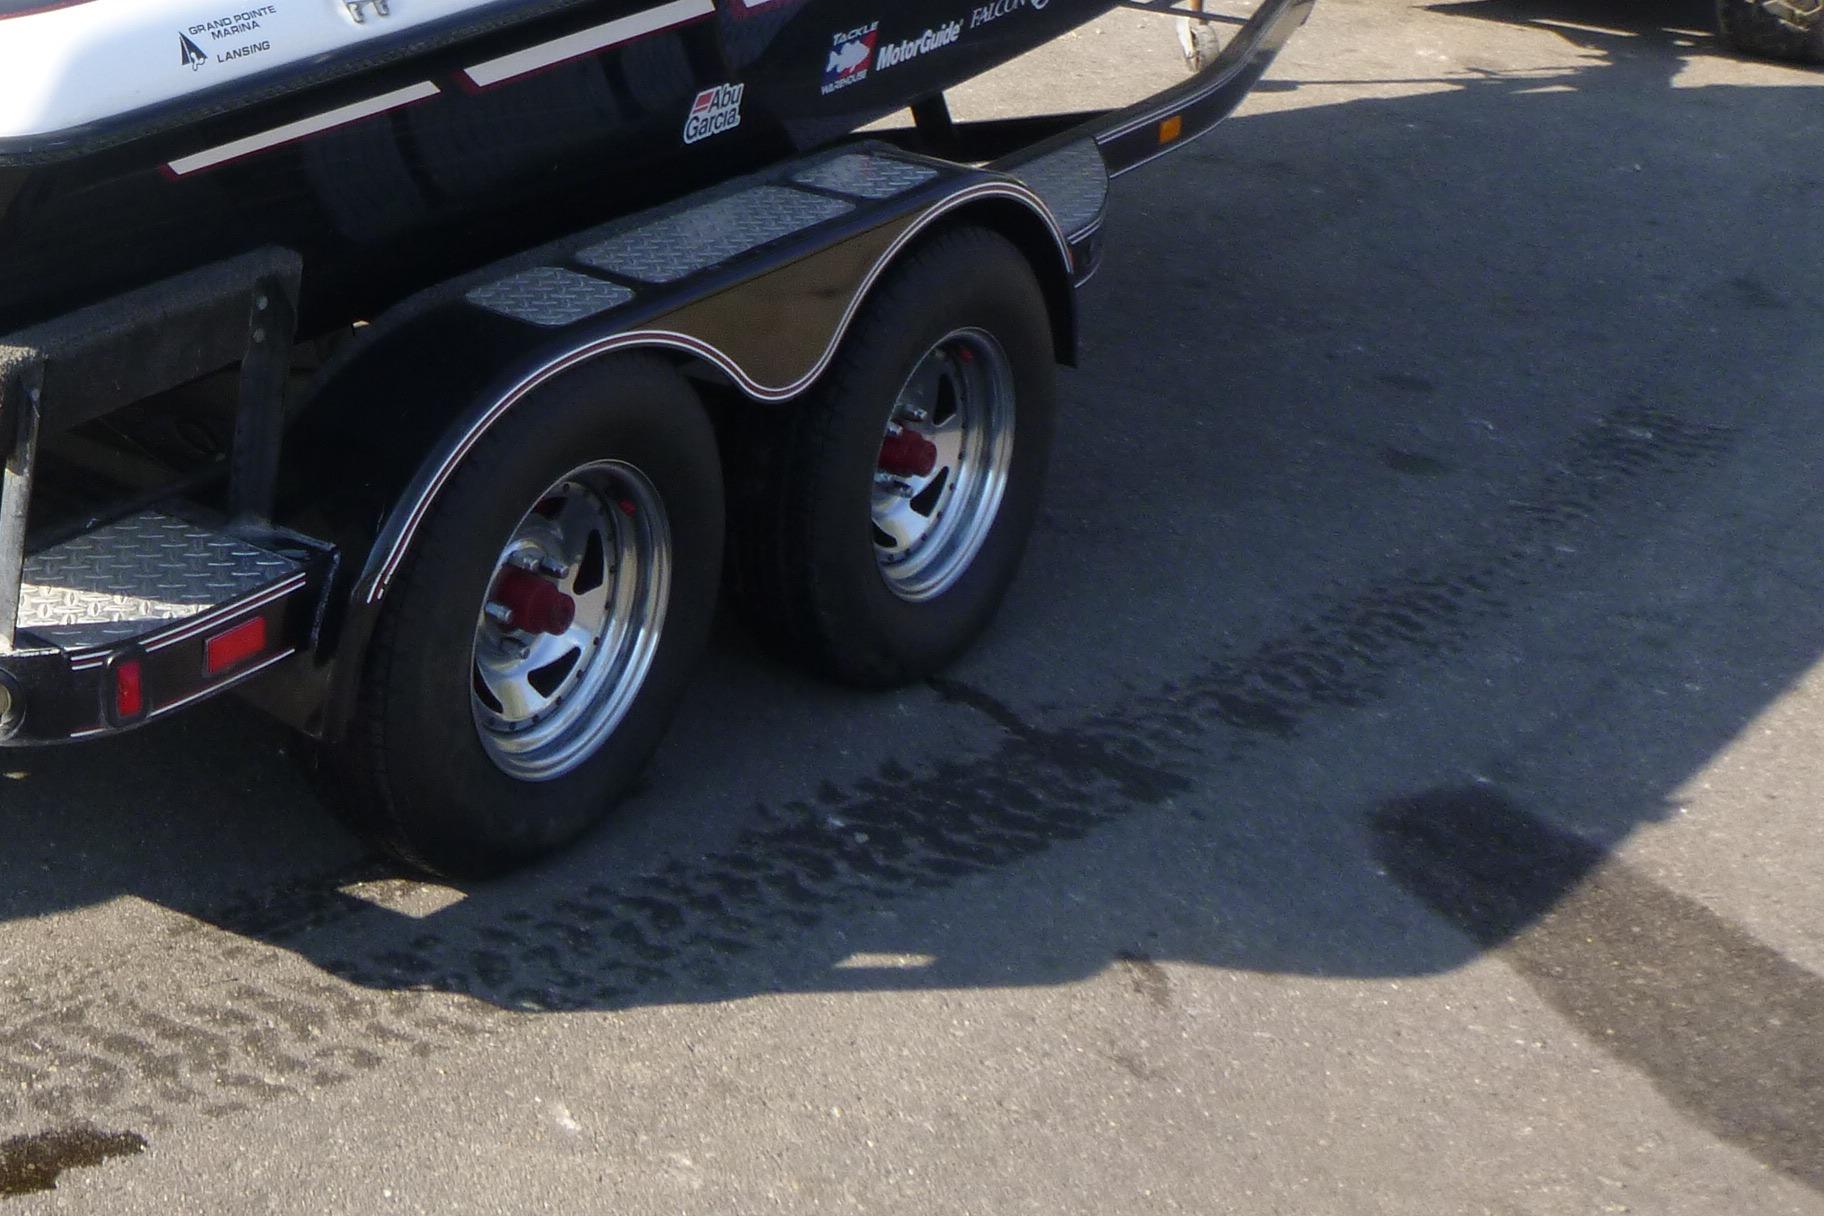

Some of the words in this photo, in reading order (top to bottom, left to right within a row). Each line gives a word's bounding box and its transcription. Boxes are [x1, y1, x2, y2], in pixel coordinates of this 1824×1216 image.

[188, 17, 232, 35] GRAND
[233, 5, 277, 24] POINTE
[211, 20, 261, 41] MARINA
[833, 20, 880, 46] TACKLE
[216, 40, 271, 64] LANSING
[875, 20, 962, 72] MotorGuide
[708, 85, 742, 113] Abu
[685, 107, 738, 141] Garcia
